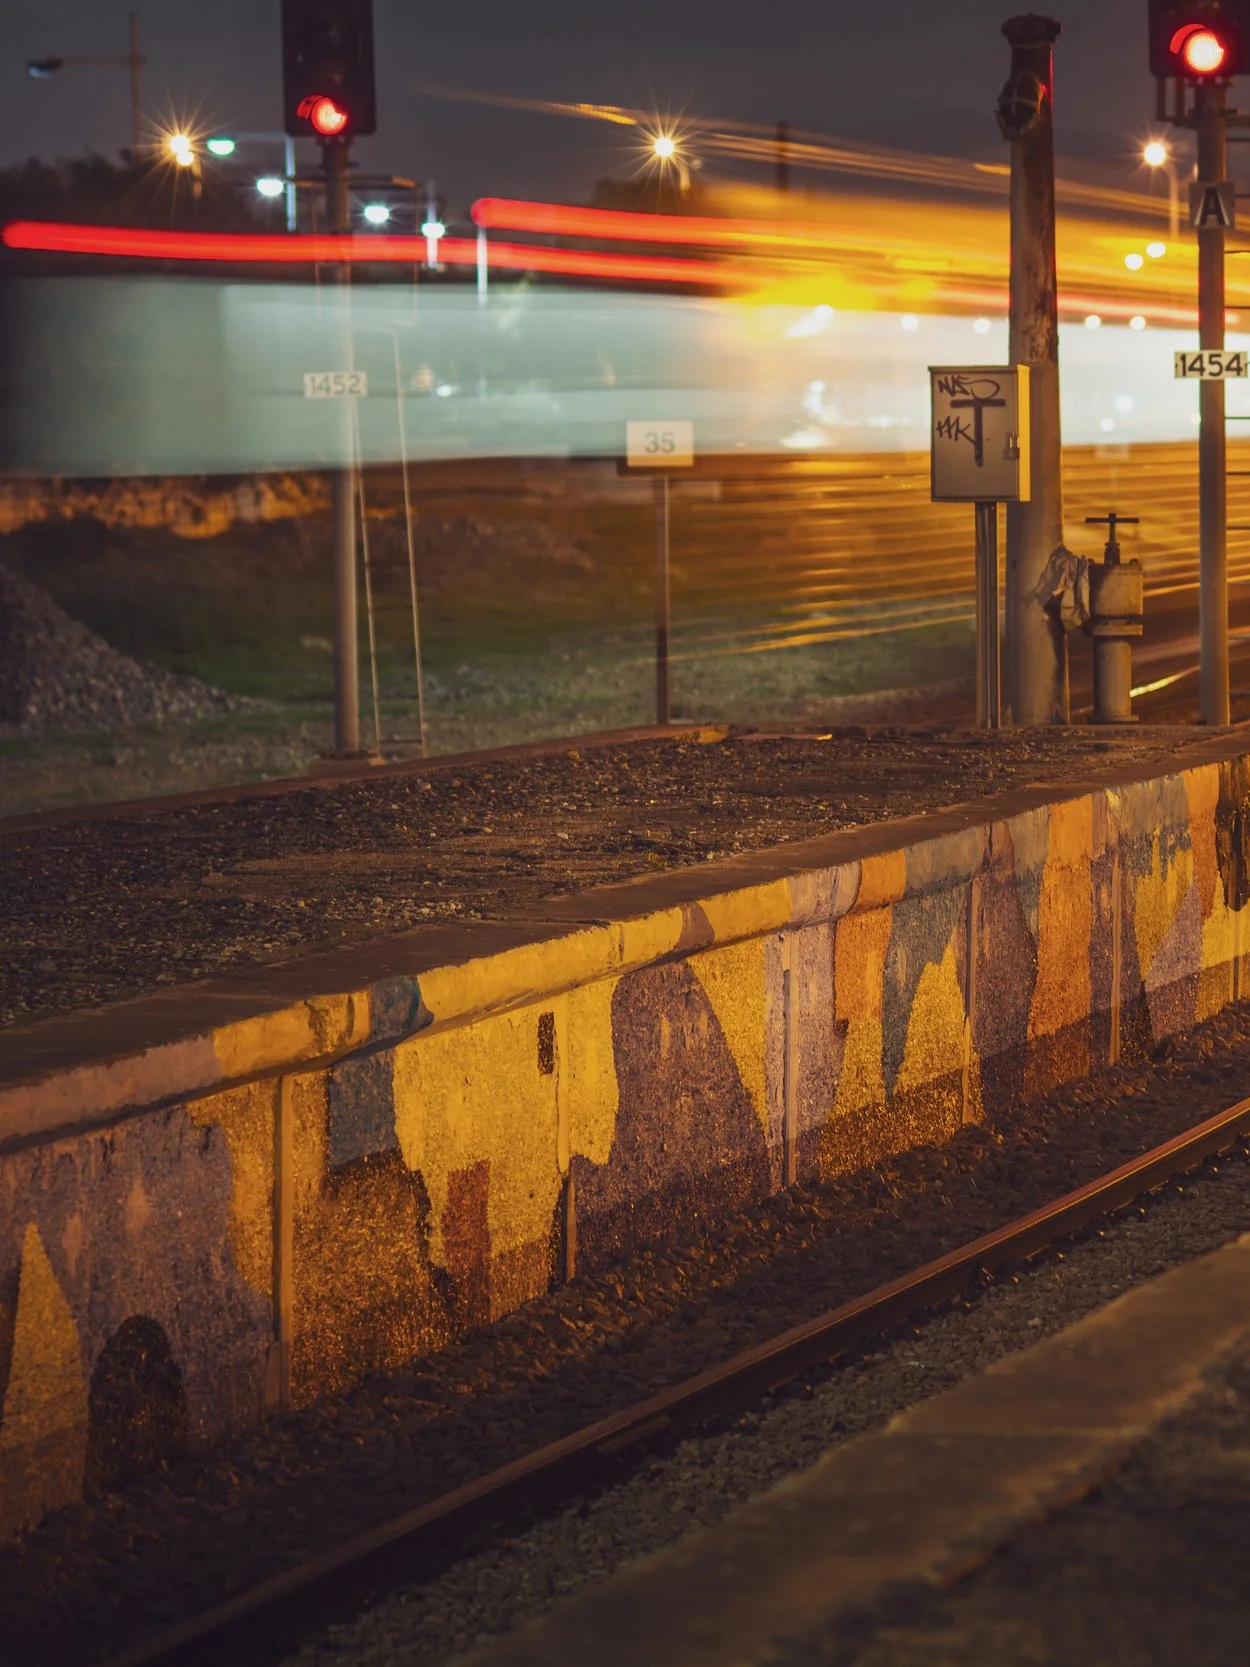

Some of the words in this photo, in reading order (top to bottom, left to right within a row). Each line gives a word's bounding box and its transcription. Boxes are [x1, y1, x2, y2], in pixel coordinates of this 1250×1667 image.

[1195, 187, 1229, 225] A
[1179, 353, 1243, 376] 1454
[310, 374, 360, 395] 1452
[645, 431, 676, 454] 35
